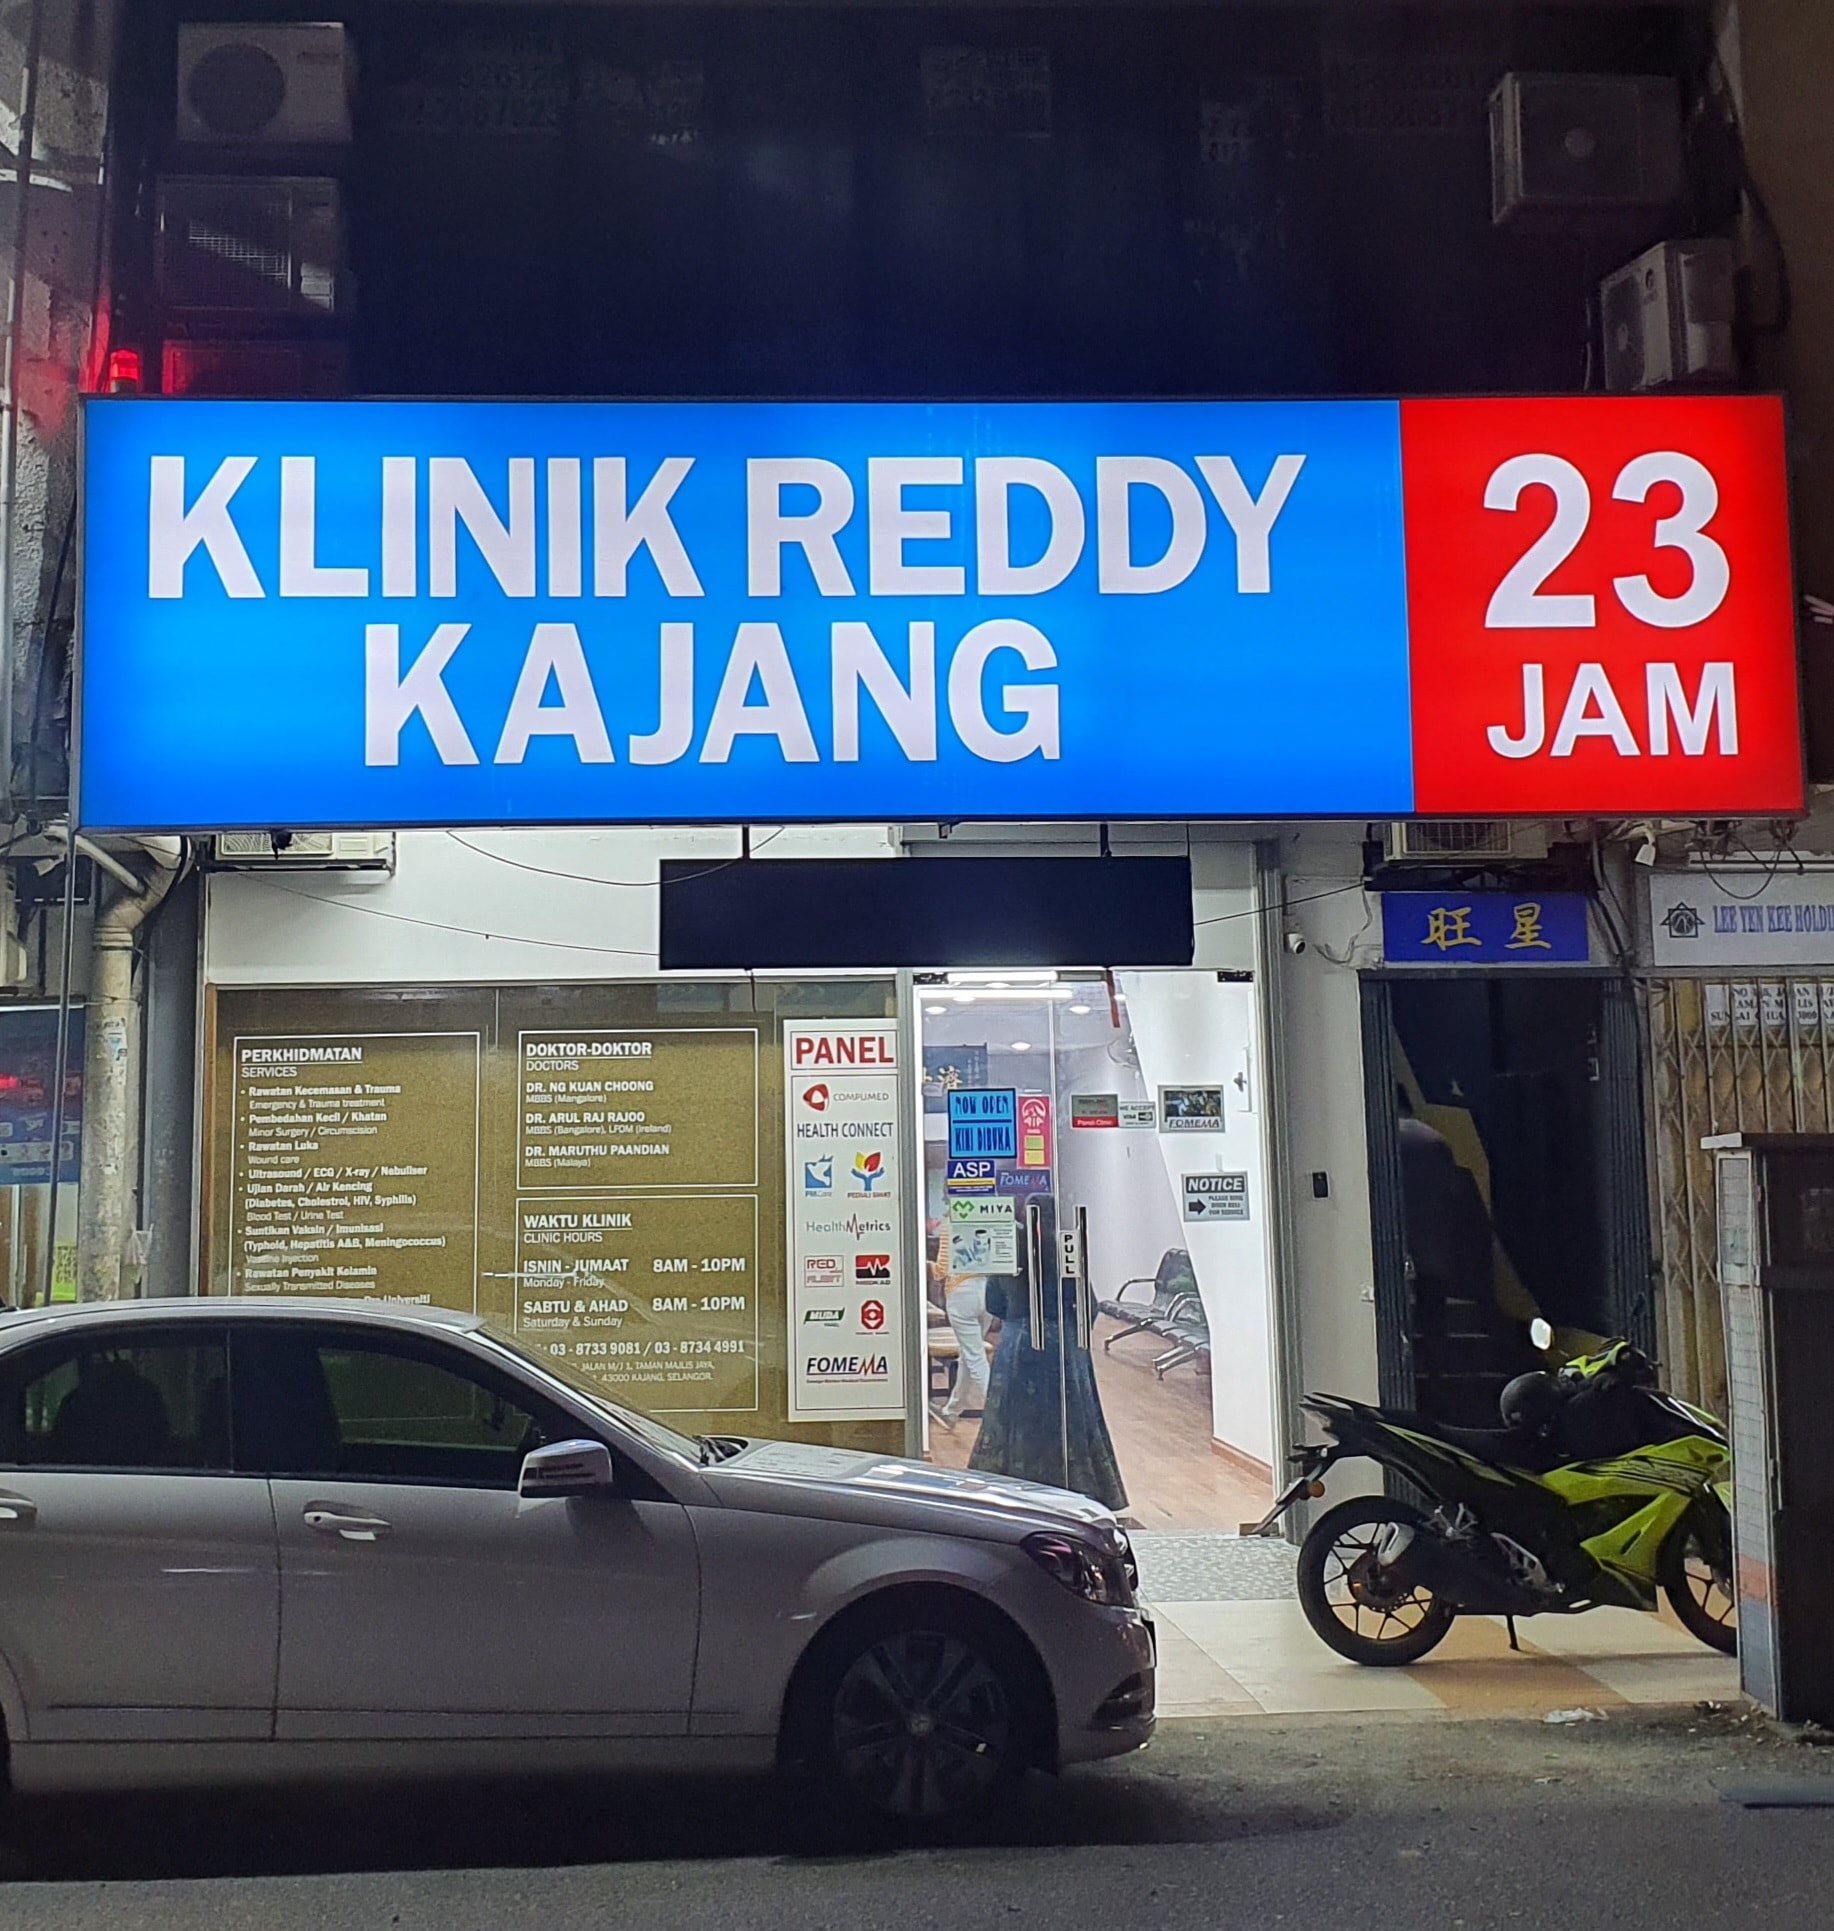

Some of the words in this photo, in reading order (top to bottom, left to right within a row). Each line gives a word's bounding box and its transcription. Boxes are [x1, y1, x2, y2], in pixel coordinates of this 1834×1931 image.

[148, 455, 705, 598] KLINIK
[746, 454, 1306, 597] REDDY
[1483, 451, 1730, 628] 23
[364, 618, 1060, 766] KAJANG
[1486, 662, 1738, 759] JAM
[1713, 905, 1737, 933] LEE
[1739, 905, 1763, 933] YEN
[1766, 905, 1792, 932] KEE
[1795, 904, 1834, 932] HOLDI
[1420, 902, 1551, 950] 旺星
[241, 1047, 362, 1062] PERKHIDMATAN
[526, 1042, 652, 1056] DOKTOR-DOKTOR
[796, 1036, 894, 1064] PANEL
[526, 1060, 579, 1071] DOCTORS
[241, 1067, 297, 1078] SERVICES
[249, 1086, 292, 1096] Rawatan
[294, 1085, 352, 1095] Kecemasan
[353, 1084, 363, 1094] &
[364, 1084, 401, 1094] Trauma
[526, 1082, 546, 1093] DR.
[549, 1082, 566, 1092] NG
[569, 1081, 601, 1092] KUAN
[604, 1081, 654, 1091] CHOONG
[525, 1094, 553, 1103] MBBS
[833, 1093, 889, 1101] COMPUMED
[249, 1100, 297, 1111] Emergency
[308, 1099, 341, 1108] Trauma
[249, 1113, 313, 1123] Pembedahan
[315, 1112, 341, 1122] Kecil
[341, 1112, 349, 1124] /
[351, 1111, 387, 1122] Khatan
[525, 1113, 546, 1123] DR.
[548, 1112, 581, 1123] ARUL
[583, 1112, 604, 1123] RAJ
[607, 1111, 645, 1122] RAJOO
[1169, 1119, 1220, 1128] FOMEMA
[249, 1127, 273, 1137] Minor
[275, 1127, 309, 1138] Surgery
[310, 1127, 317, 1138] /
[525, 1125, 552, 1134] MBBS
[797, 1123, 838, 1138] HEALTH
[842, 1122, 894, 1138] CONNECT
[248, 1141, 292, 1151] Rawatan
[294, 1140, 318, 1150] Luka
[525, 1146, 545, 1156] DR.
[548, 1145, 607, 1156] MARUTHU
[610, 1144, 669, 1155] PAANDIAN
[248, 1155, 278, 1164] Wound
[280, 1156, 300, 1164] care
[525, 1158, 552, 1167] MBBS
[303, 1168, 312, 1180] /
[313, 1168, 335, 1178] ECG
[335, 1167, 343, 1178] /
[345, 1167, 370, 1178] X-ray
[371, 1166, 379, 1178] /
[953, 1162, 991, 1178] ASP
[247, 1184, 273, 1195] Ujian
[275, 1183, 305, 1193] Darah
[305, 1182, 314, 1194] /
[315, 1182, 330, 1192] Air
[332, 1181, 373, 1193] Kencing
[1188, 1178, 1243, 1191] NOTICE
[353, 1195, 373, 1206] HIV,
[374, 1194, 417, 1206] Syphilis)
[247, 1212, 272, 1221] Blood
[273, 1212, 291, 1221] Test
[292, 1211, 299, 1221] /
[300, 1211, 324, 1220] Urine
[325, 1210, 344, 1219] Test
[980, 1205, 1013, 1214] MIYA
[524, 1214, 578, 1228] WAKTU
[582, 1213, 632, 1227] KLINIK
[806, 1214, 891, 1239] HealthMetrics
[245, 1226, 290, 1236] Suntikan
[292, 1225, 325, 1235] Vaksin
[326, 1224, 334, 1237] /
[336, 1223, 383, 1233] Imunisasi
[523, 1232, 560, 1243] CLINIC
[563, 1231, 603, 1243] HOURS
[244, 1240, 288, 1252] (Typhoid,
[290, 1239, 335, 1251] Hepatitis
[1064, 1234, 1075, 1274] PULL
[524, 1260, 562, 1273] ISNIN
[573, 1258, 629, 1273] JUMAAT
[653, 1259, 688, 1272] 8AM
[701, 1258, 745, 1272] 10PM
[807, 1259, 836, 1269] RED
[245, 1268, 289, 1278] Rawatan
[291, 1266, 334, 1279] Penyakit
[336, 1265, 377, 1276] Kelamin
[523, 1277, 564, 1289] Monday
[573, 1276, 604, 1288] Friday
[523, 1301, 571, 1313] SABTU
[573, 1301, 586, 1312] &
[588, 1300, 628, 1313] AHAD
[652, 1298, 688, 1311] 8AM
[700, 1297, 745, 1310] 10PM
[523, 1317, 570, 1328] Saturday
[572, 1316, 582, 1326] &
[583, 1316, 622, 1328] Sunday
[550, 1343, 566, 1355] 03
[575, 1343, 607, 1355] 8733
[610, 1342, 640, 1354] 9081
[643, 1341, 652, 1356] /
[654, 1342, 670, 1353] 03
[680, 1341, 711, 1353] 8734
[714, 1340, 744, 1353] 4991
[581, 1362, 606, 1371] JALAN
[636, 1361, 663, 1370] TAMAN
[665, 1361, 694, 1369] MAJLIS
[806, 1354, 888, 1375] FOMEMA
[602, 1373, 630, 1382] 43000
